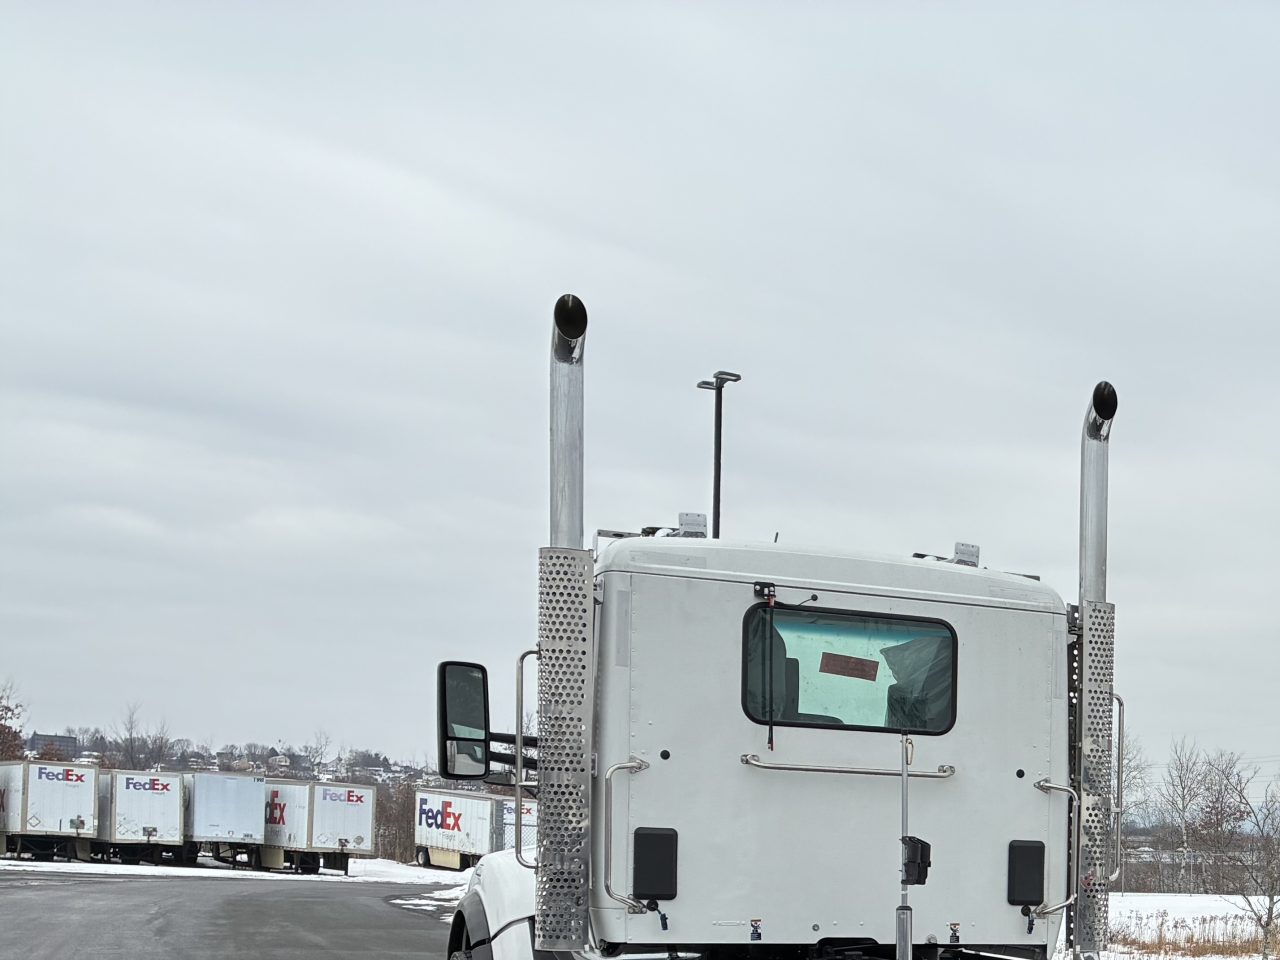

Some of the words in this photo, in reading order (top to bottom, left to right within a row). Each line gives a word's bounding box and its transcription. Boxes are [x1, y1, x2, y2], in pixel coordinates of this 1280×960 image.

[38, 767, 85, 782] FedEx
[125, 778, 170, 791] FedEx
[323, 788, 364, 803] FedEx
[265, 790, 286, 825] dEx
[418, 798, 462, 832] FedEx
